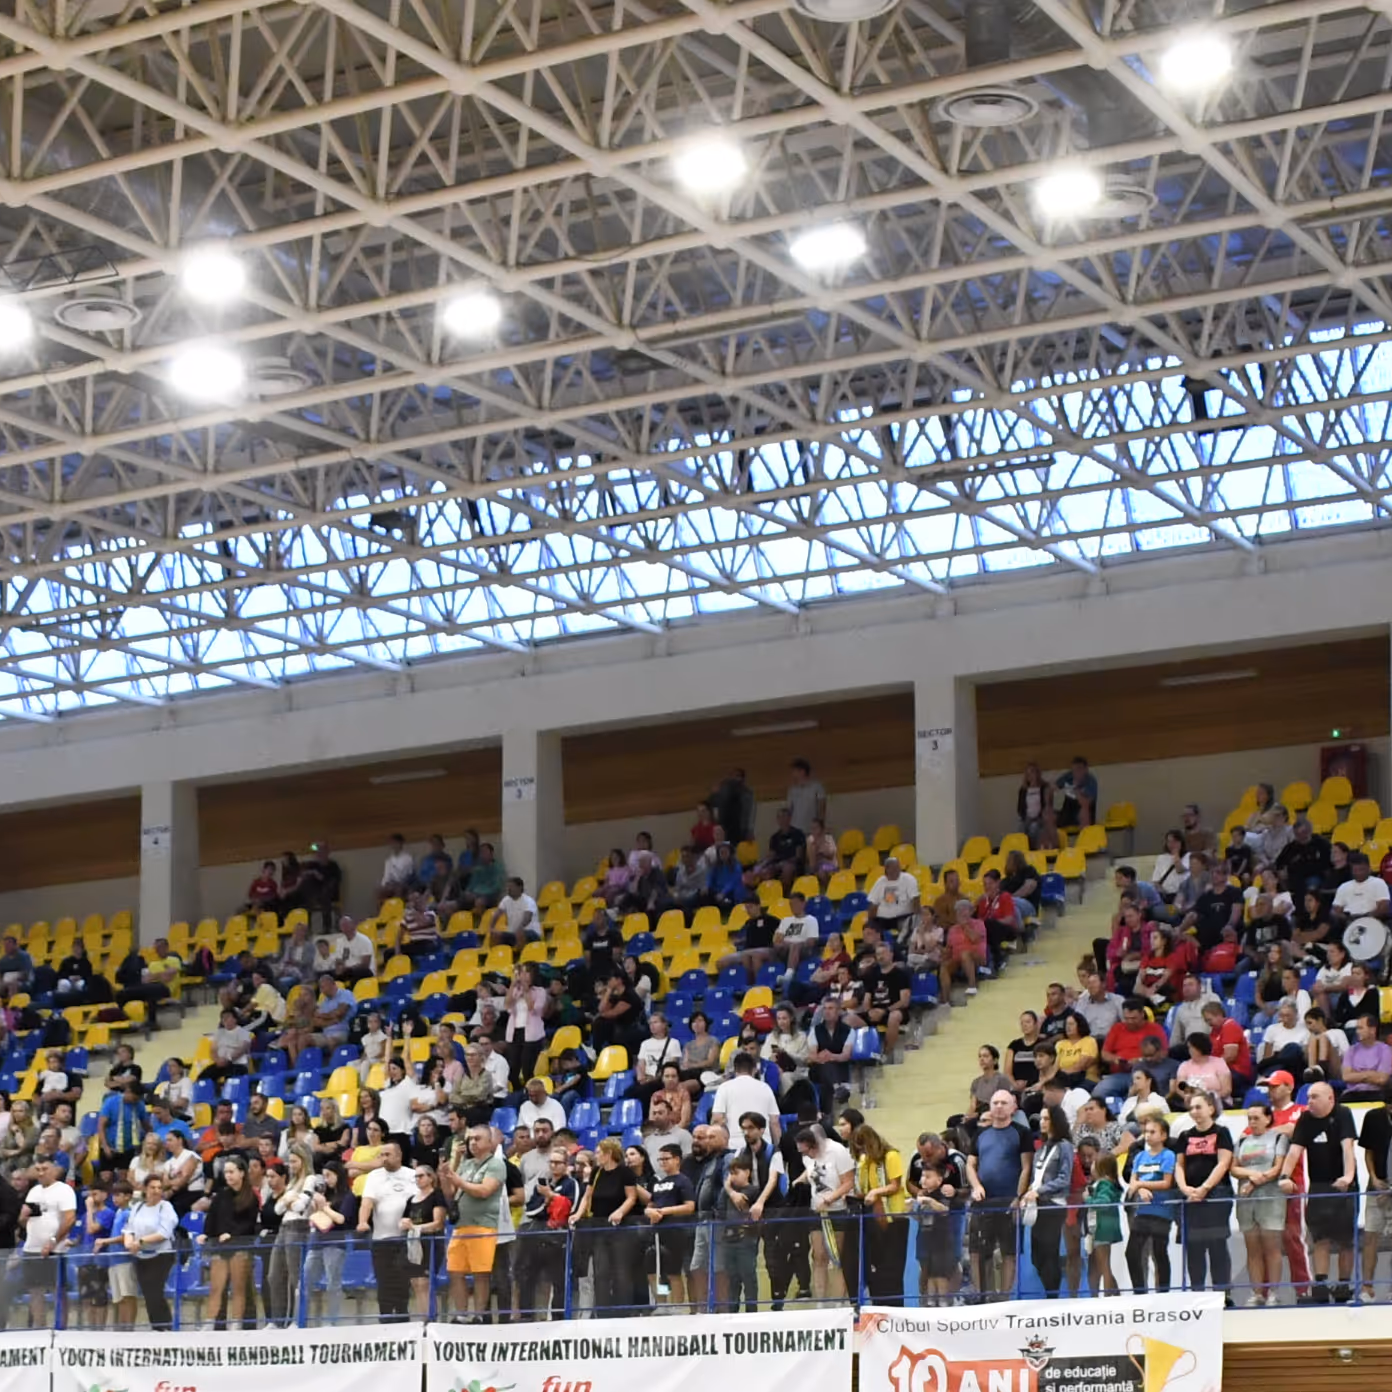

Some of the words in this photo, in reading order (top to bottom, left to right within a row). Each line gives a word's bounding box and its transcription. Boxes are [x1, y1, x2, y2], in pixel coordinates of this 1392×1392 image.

[877, 1317, 931, 1333] Clubul
[937, 1314, 999, 1336] Sportiv
[1006, 1311, 1125, 1330] Transilvania
[1132, 1308, 1204, 1325] Brasov
[59, 1347, 105, 1367] YOUTH
[110, 1345, 223, 1367] INTERNATIONAL
[228, 1344, 304, 1365] HANDBALL
[310, 1340, 417, 1364] TOURNAMENT
[434, 1340, 486, 1362] YOUTH
[491, 1337, 622, 1361] INTERNATIONAL
[628, 1333, 718, 1358] HANDBALL
[723, 1329, 847, 1354] TOURNAMENT
[1045, 1366, 1061, 1380] de
[1063, 1364, 1117, 1381] educație
